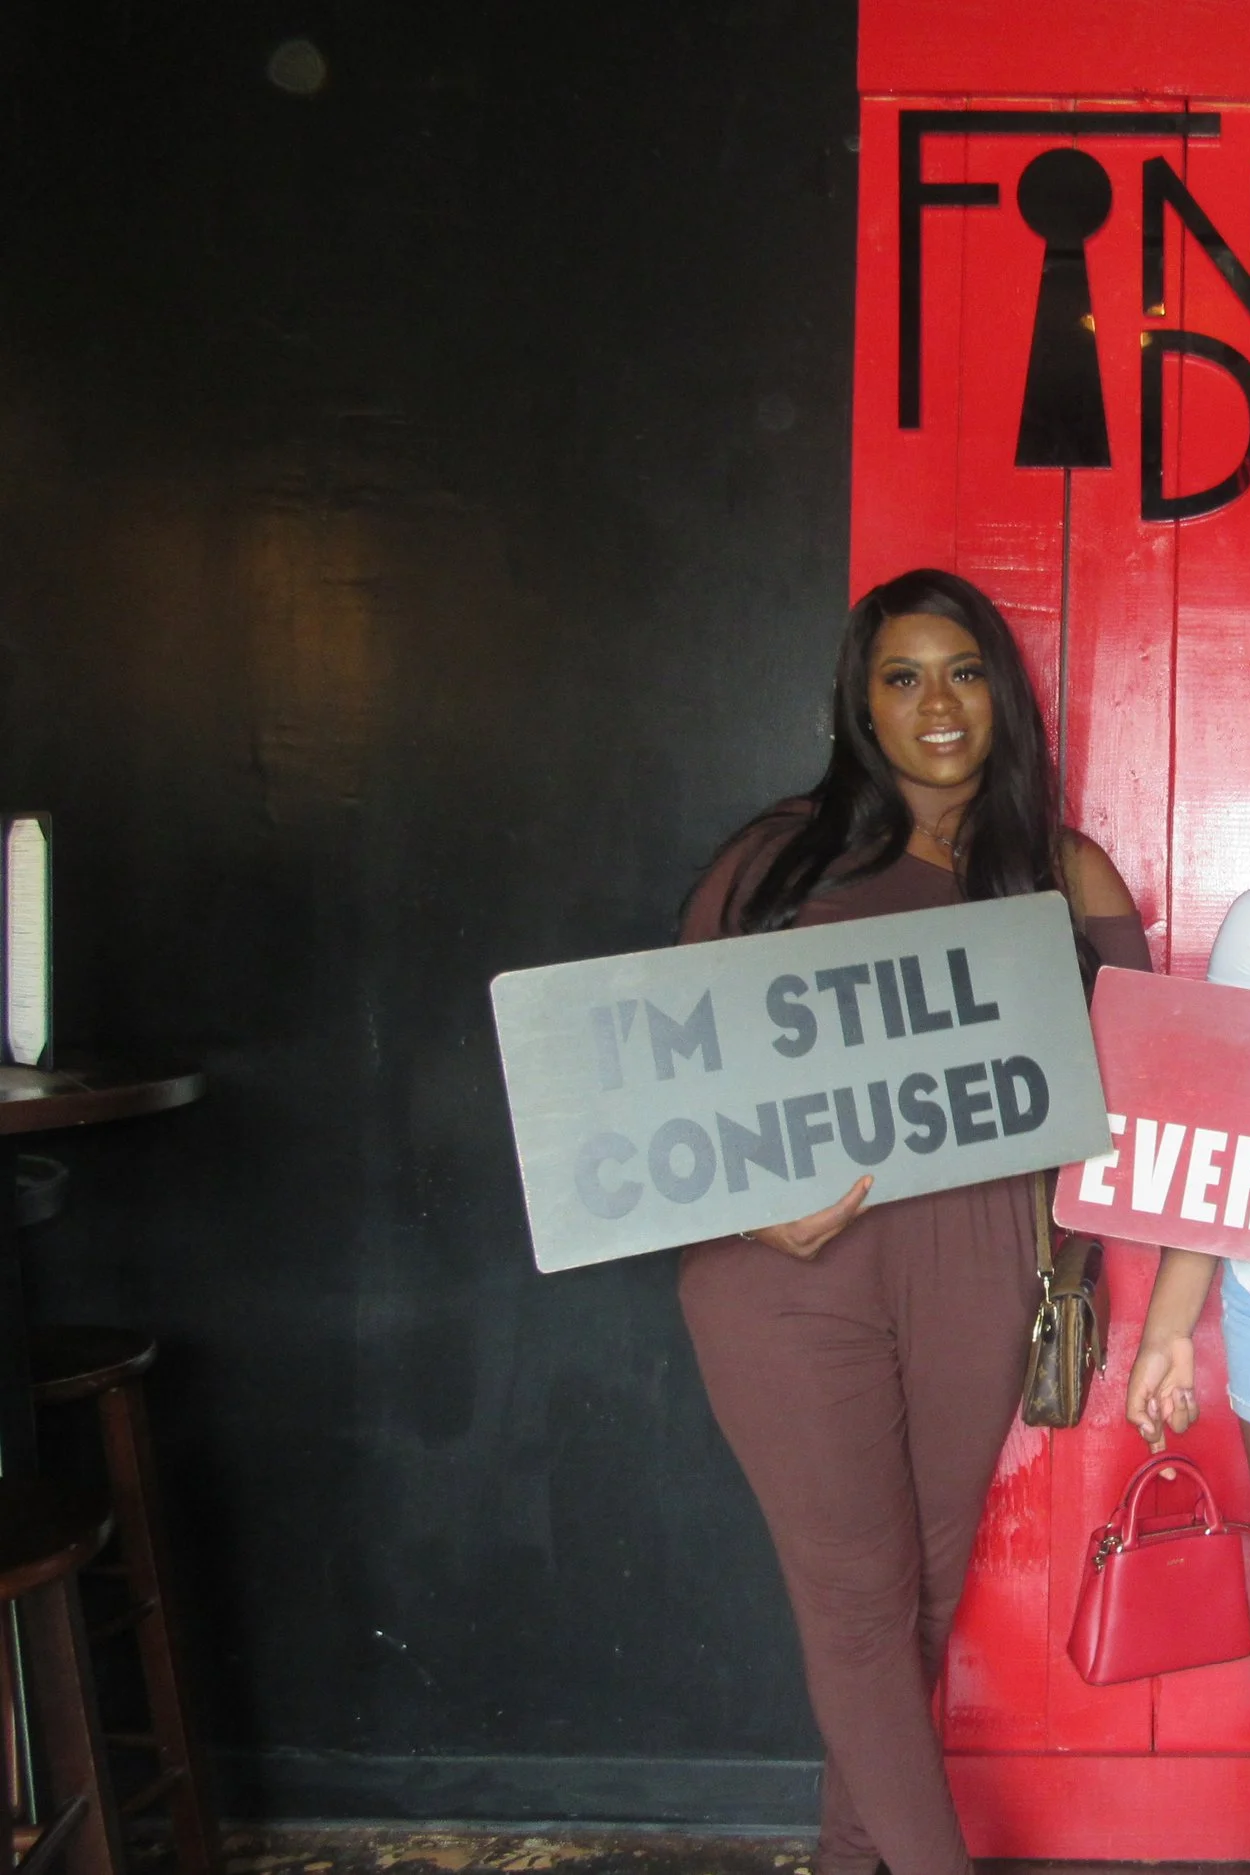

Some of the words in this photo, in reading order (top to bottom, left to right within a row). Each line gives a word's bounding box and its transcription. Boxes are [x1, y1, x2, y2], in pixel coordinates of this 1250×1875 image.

[591, 989, 723, 1092] I'M
[765, 947, 1000, 1058] STILL
[574, 1055, 1050, 1220] CONFUSED
